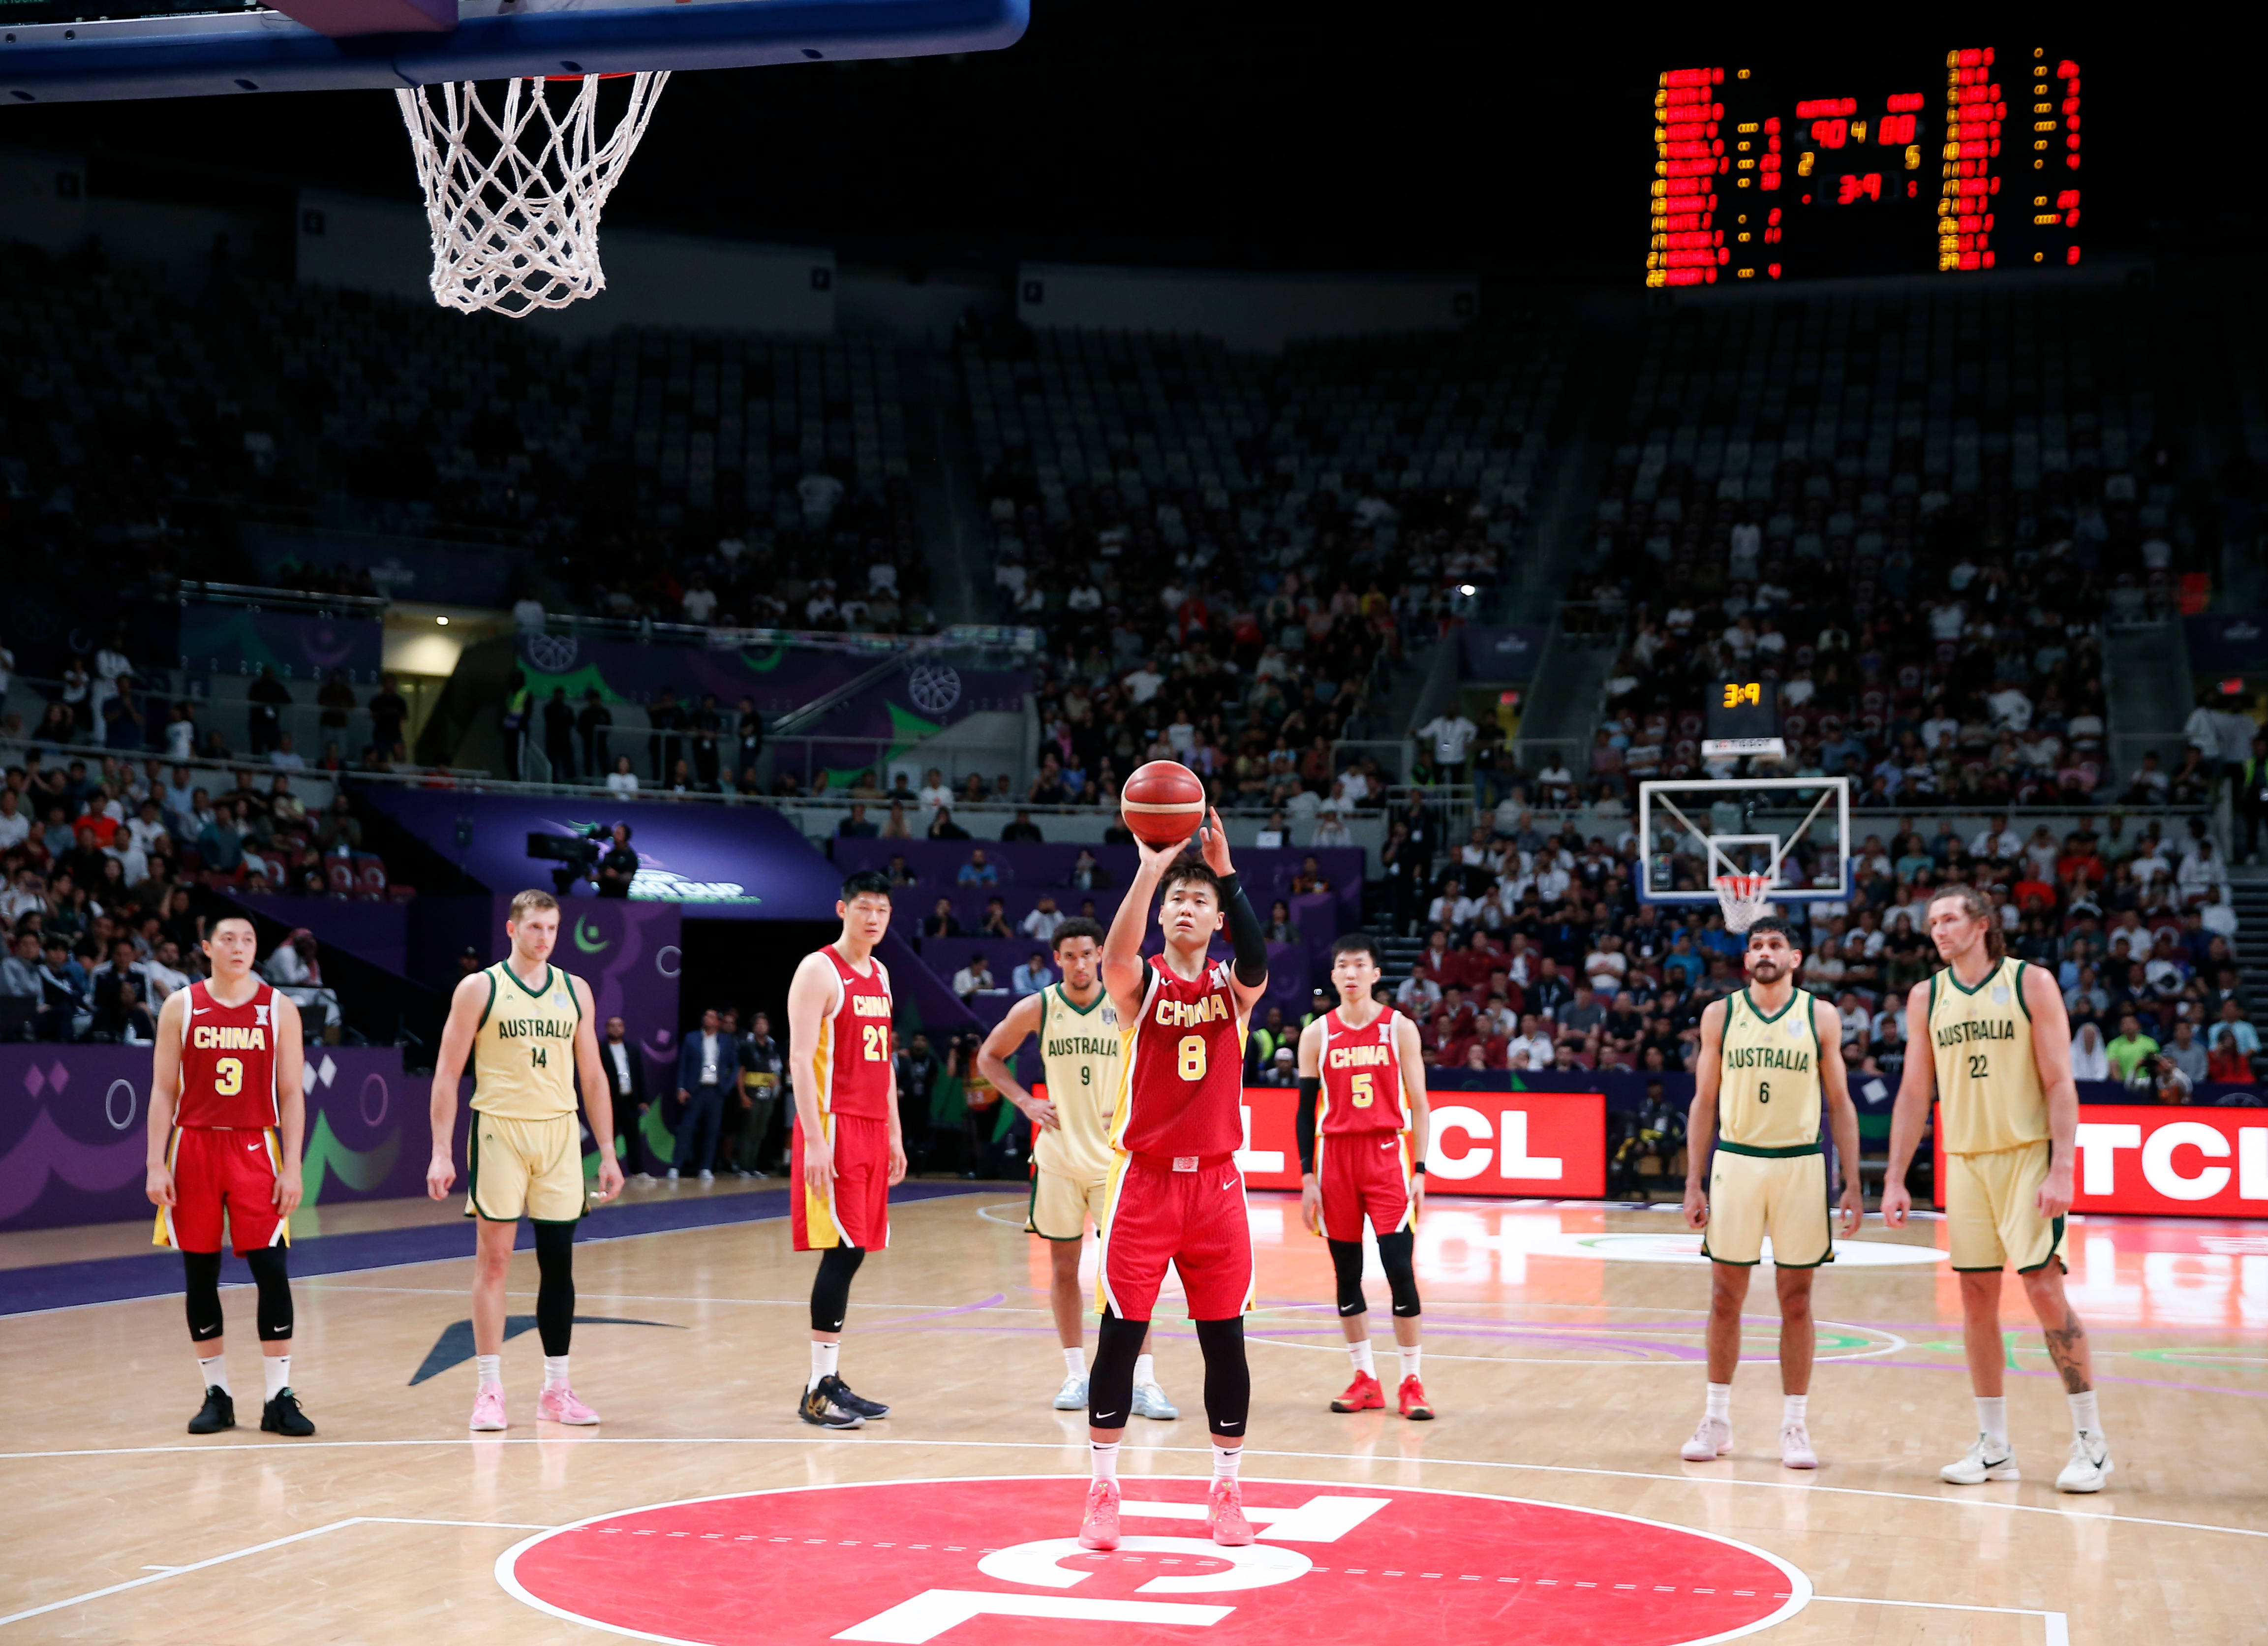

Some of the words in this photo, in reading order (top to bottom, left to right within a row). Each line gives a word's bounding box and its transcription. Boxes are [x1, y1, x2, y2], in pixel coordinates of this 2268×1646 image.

[1851, 121, 1867, 143] 4
[1798, 152, 1814, 176] 2
[1904, 145, 1921, 169] 5
[853, 995, 891, 1018] CHINA
[1156, 994, 1228, 1027] CHINA
[194, 1026, 266, 1051] CHINA
[499, 1019, 572, 1039] AUSTRALIA
[1938, 1020, 2015, 1049] AUSTRALIA
[863, 1025, 888, 1061] 21
[1048, 1037, 1117, 1056] AUSTRALIA
[532, 1047, 547, 1068] 14
[1178, 1035, 1206, 1081] 8
[1329, 1045, 1390, 1069] CHINA
[1728, 1047, 1808, 1073] AUSTRALIA
[1969, 1054, 1988, 1078] 22
[215, 1057, 243, 1096] 3
[1081, 1066, 1090, 1085] 9
[1351, 1073, 1374, 1108] 5
[1759, 1082, 1769, 1103] 6
[1407, 1106, 1563, 1180] CL
